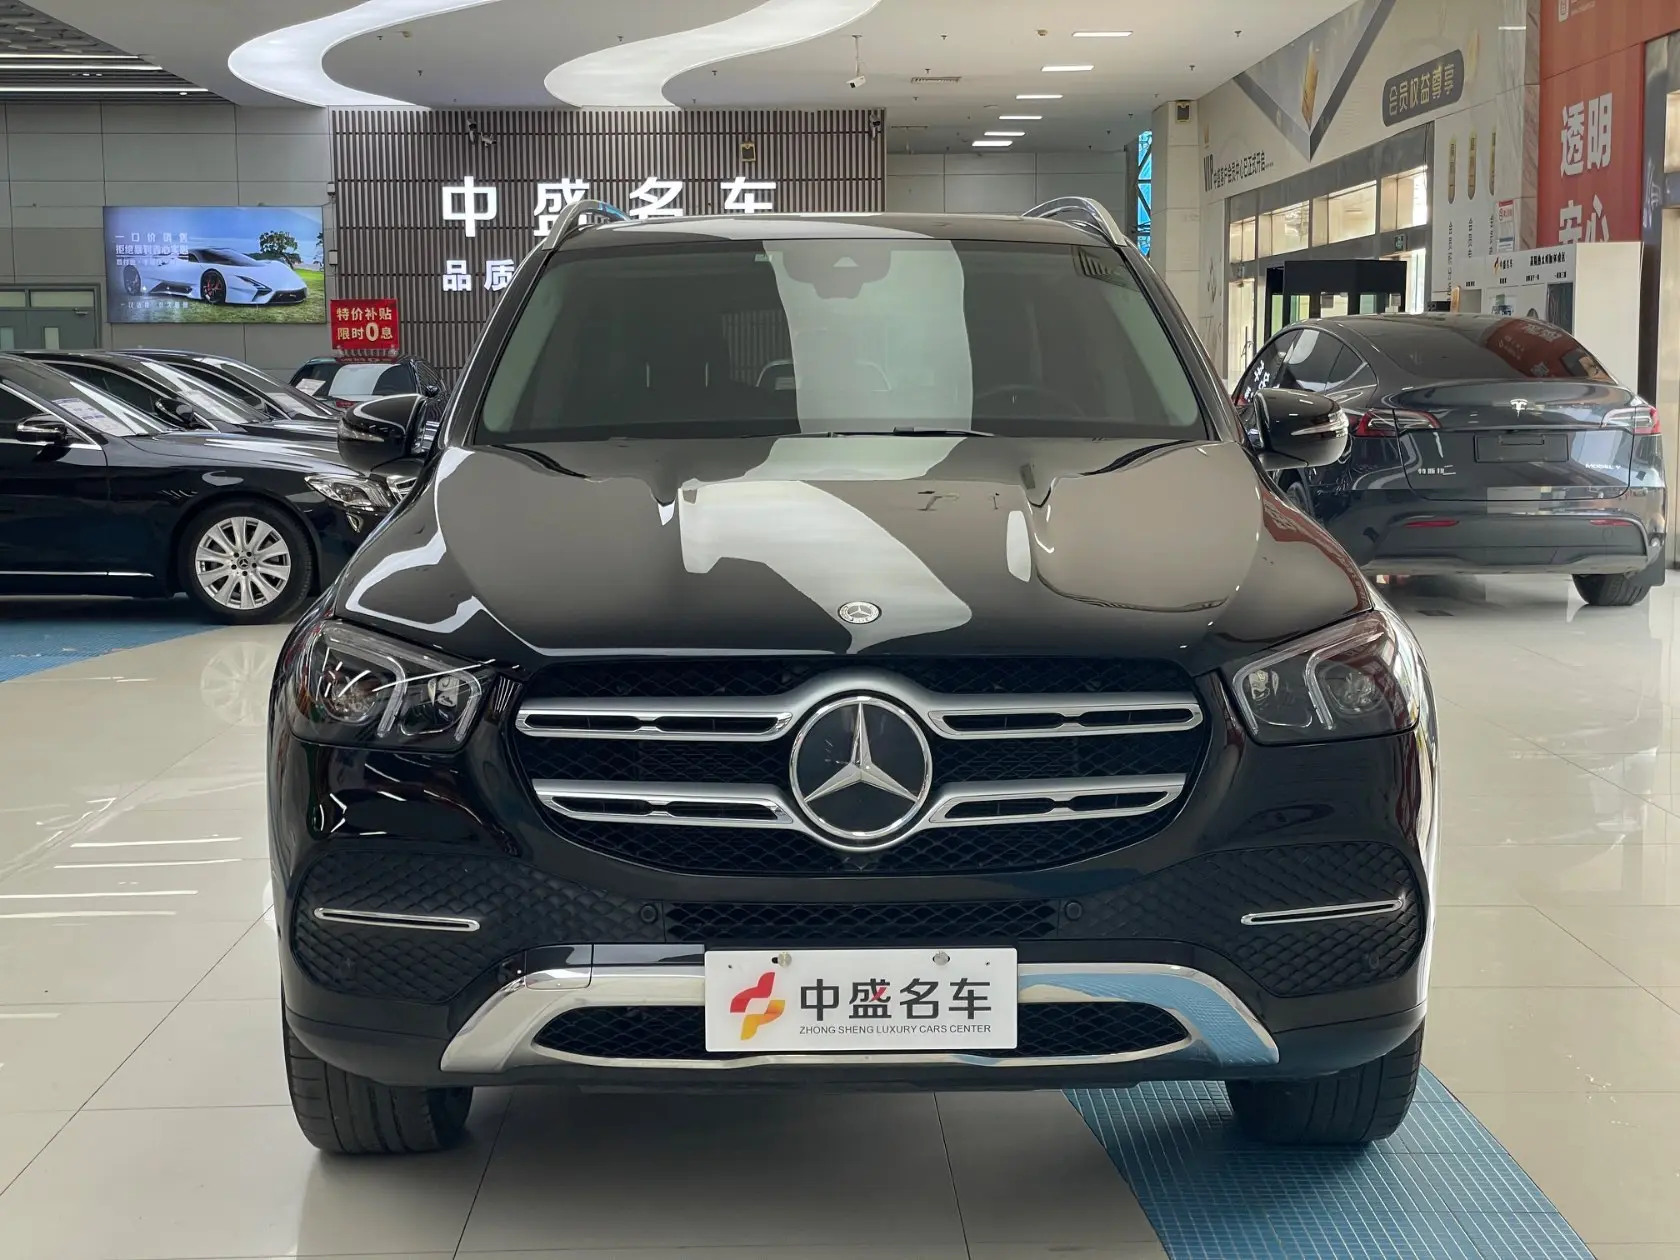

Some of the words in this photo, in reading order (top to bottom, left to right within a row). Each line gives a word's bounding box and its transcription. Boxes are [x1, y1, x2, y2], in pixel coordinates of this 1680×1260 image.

[1389, 63, 1455, 116] 会员权益尊享
[1561, 93, 1613, 177] 透明
[442, 176, 777, 237] 中盛名车
[1558, 194, 1610, 244] 安心
[336, 307, 392, 321] 特价补贴
[337, 322, 393, 342] 限时0息
[800, 978, 992, 1021] 中盛名车
[800, 1026, 836, 1035] ZHONG
[838, 1025, 874, 1034] SHENG
[876, 1025, 917, 1034] LUXURY
[919, 1024, 947, 1033] CARS
[949, 1024, 991, 1033] CENTER
